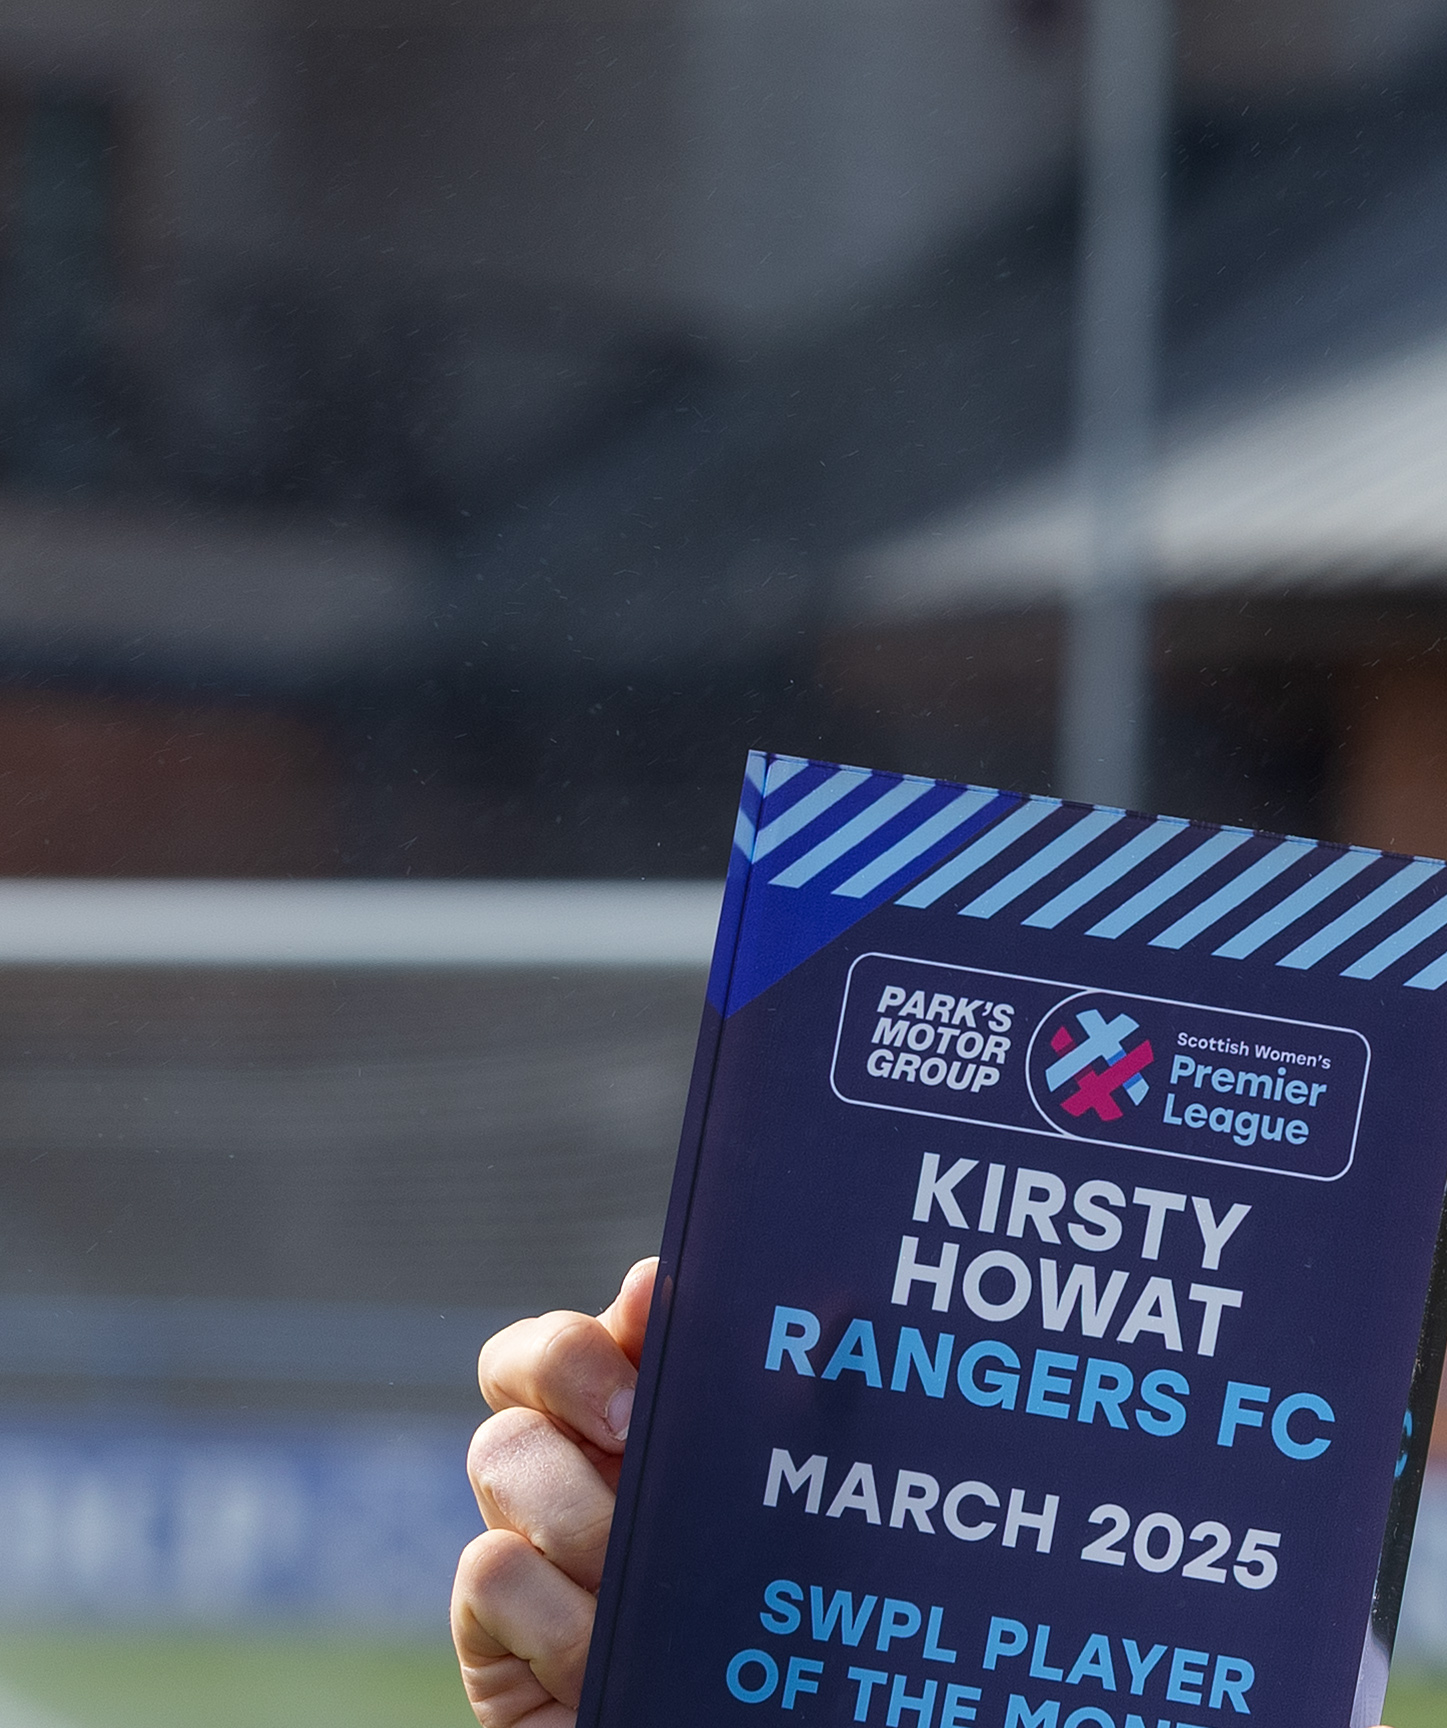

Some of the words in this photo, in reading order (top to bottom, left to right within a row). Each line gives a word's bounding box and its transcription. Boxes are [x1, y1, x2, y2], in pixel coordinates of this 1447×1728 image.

[877, 986, 1014, 1032] PARK'S
[872, 1017, 1011, 1064] MOTOR
[1178, 1033, 1249, 1056] Scottish
[1255, 1045, 1330, 1069] Women's
[867, 1049, 999, 1092] GROUP
[1170, 1055, 1327, 1106] Premier
[1164, 1093, 1308, 1146] League
[913, 1152, 1252, 1270] KIRSTY
[891, 1235, 1243, 1357] HOWAT
[765, 1306, 1189, 1436] RANGERS
[1217, 1381, 1335, 1459] FC
[763, 1448, 1059, 1553] MARCH
[1081, 1504, 1281, 1589] 2025
[761, 1580, 956, 1663] SWPL
[983, 1617, 1254, 1714] PLAYER
[727, 1650, 823, 1709] OF
